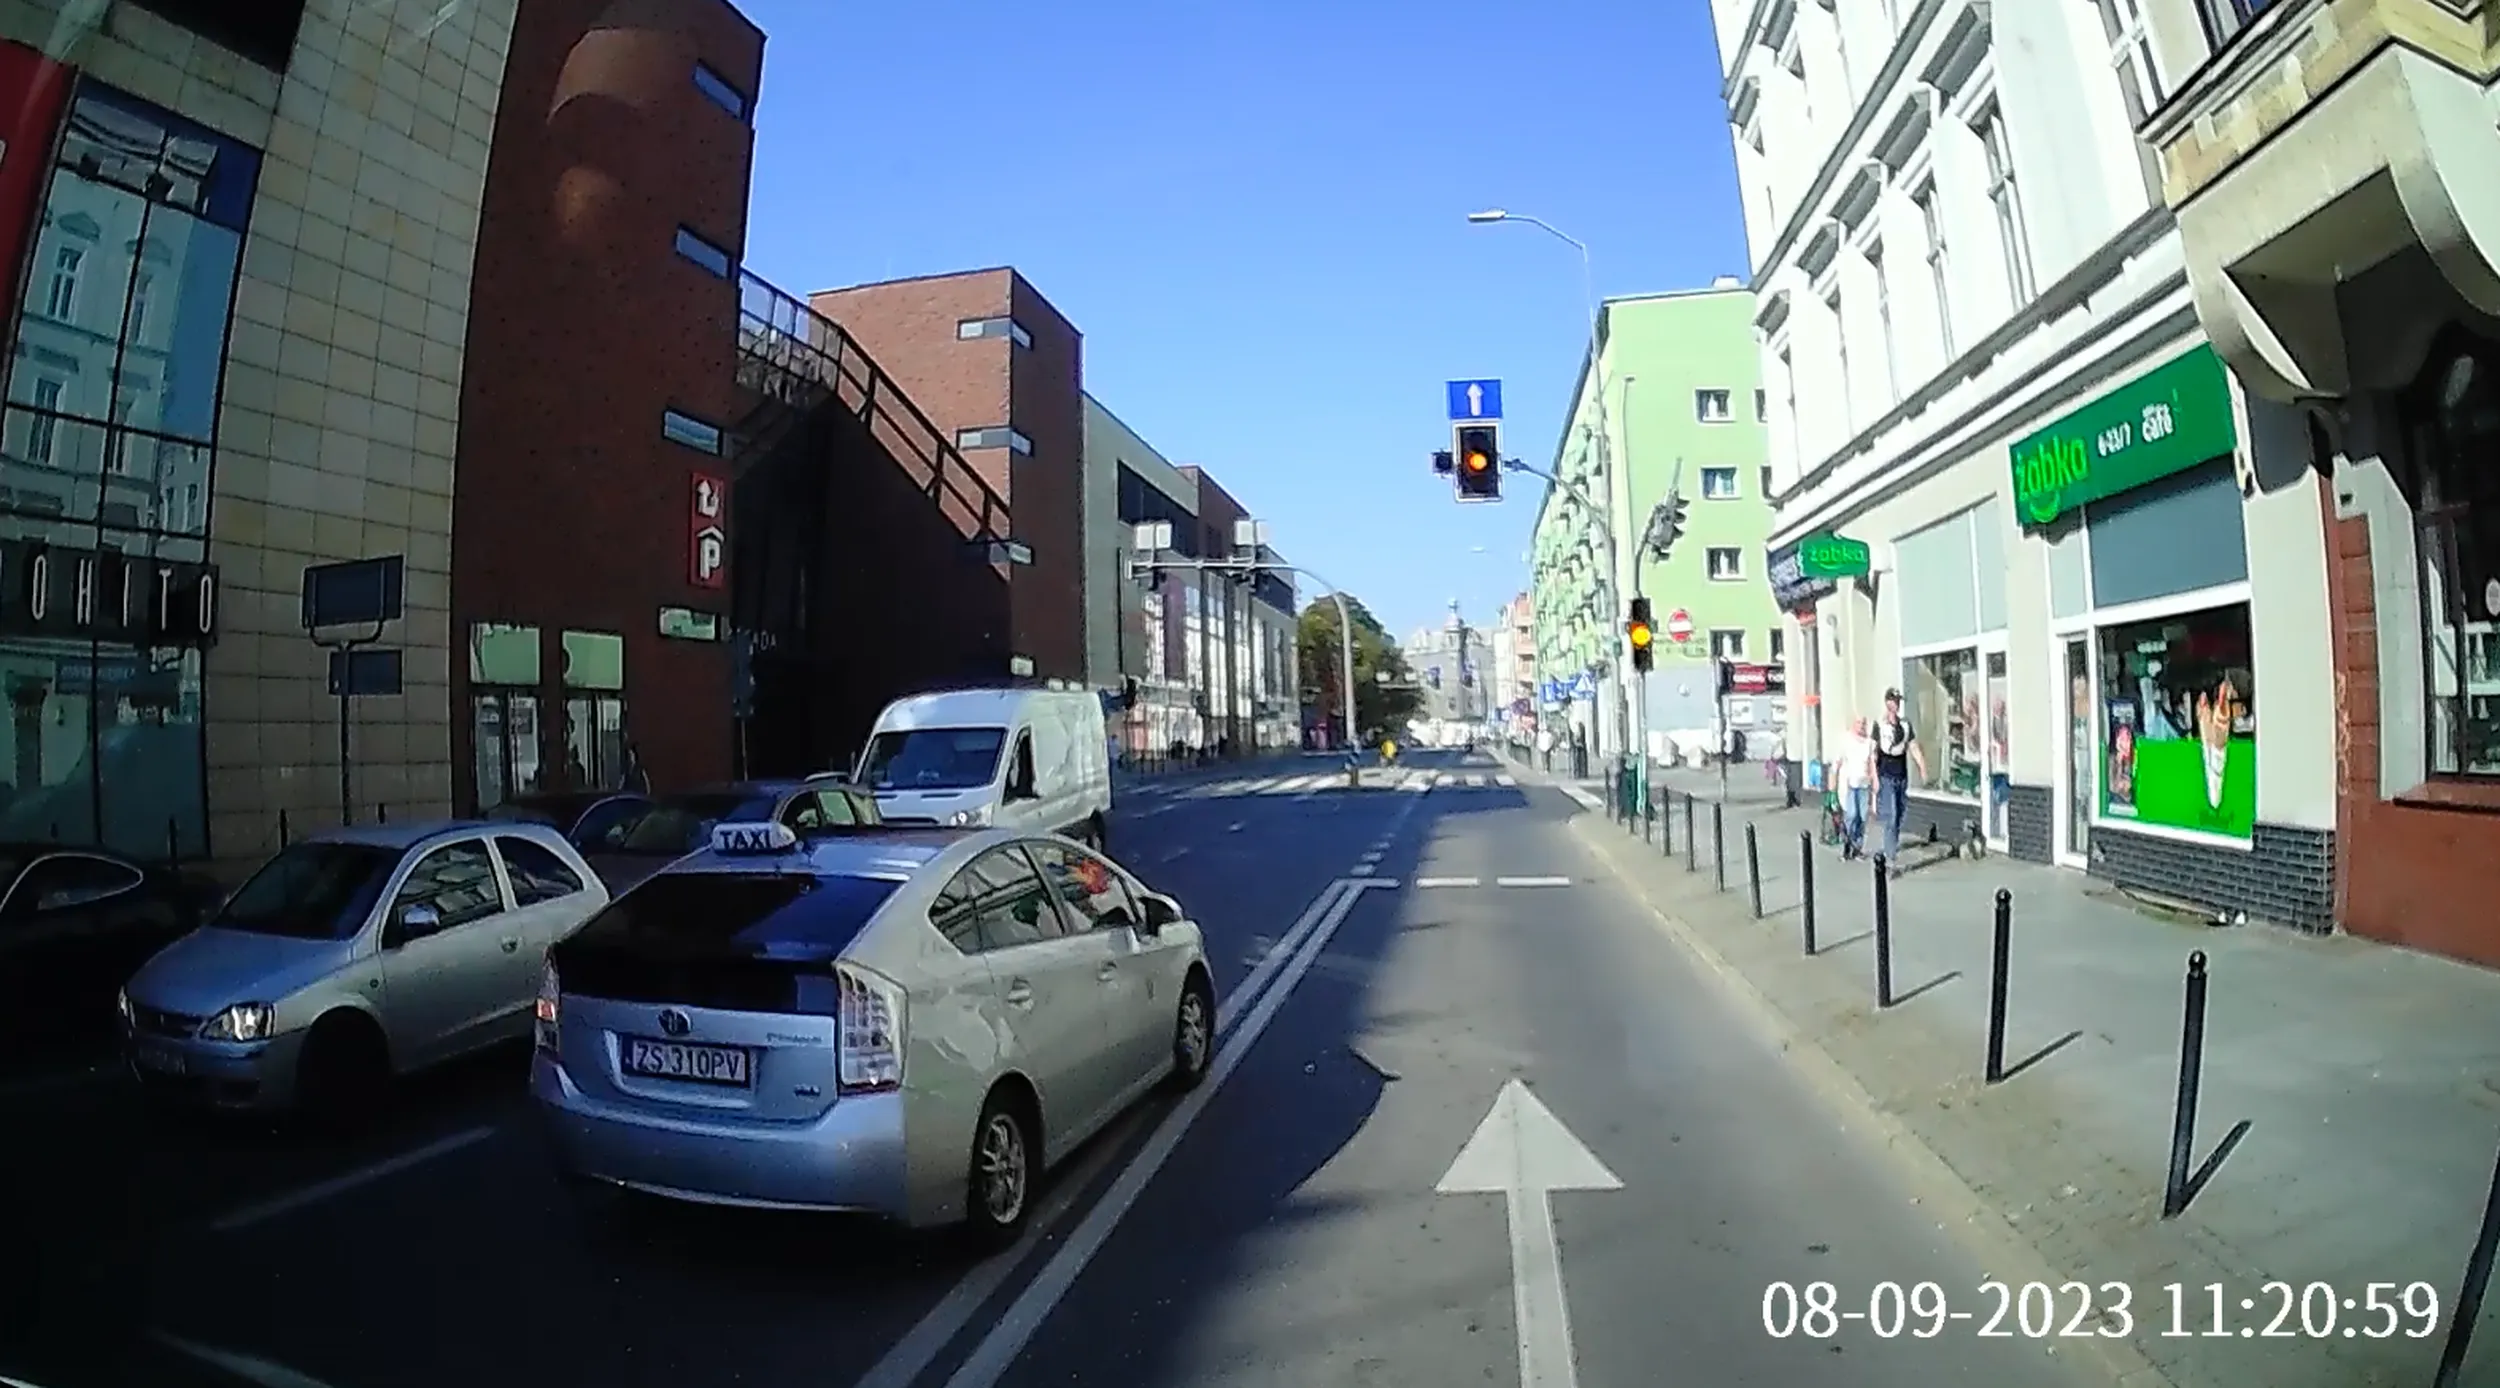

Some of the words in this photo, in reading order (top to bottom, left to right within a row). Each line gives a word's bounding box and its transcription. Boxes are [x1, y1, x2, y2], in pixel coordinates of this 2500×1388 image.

[2016, 434, 2088, 501] żabka
[1809, 545, 1866, 562] żabka
[0, 553, 212, 633] OHITO
[719, 829, 771, 851] TAXI
[637, 1043, 663, 1073] ZS
[671, 1047, 739, 1079] 310PV
